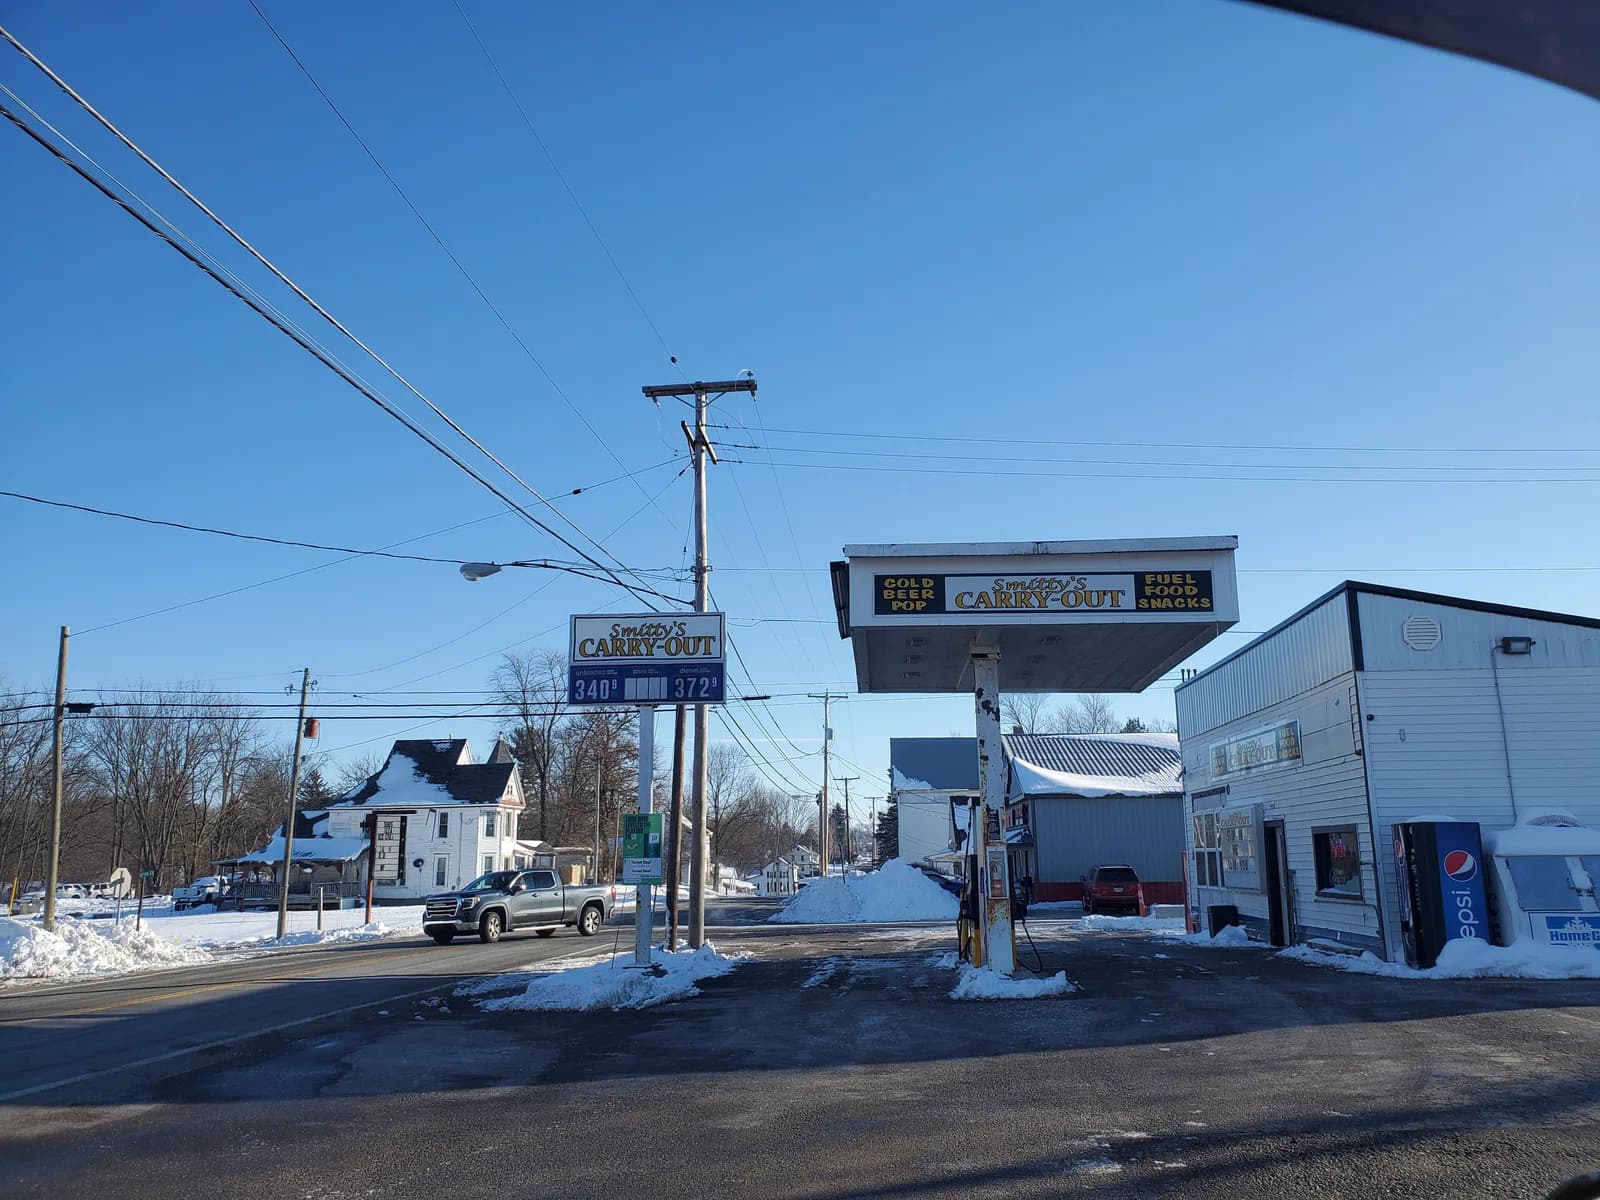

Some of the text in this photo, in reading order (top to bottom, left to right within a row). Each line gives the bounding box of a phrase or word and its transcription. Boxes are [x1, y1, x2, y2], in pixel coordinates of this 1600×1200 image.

[883, 577, 935, 589] COLD
[1144, 574, 1197, 585] FUEL
[883, 589, 935, 600] BEER
[1144, 585, 1199, 596] FOOD
[891, 600, 927, 612] POP
[954, 590, 1125, 610] CARRY-OUT
[1138, 597, 1211, 609] SNACKS
[578, 636, 717, 657] CARRY-OUT
[1451, 889, 1479, 939] epsi
[1549, 930, 1590, 943] Home
